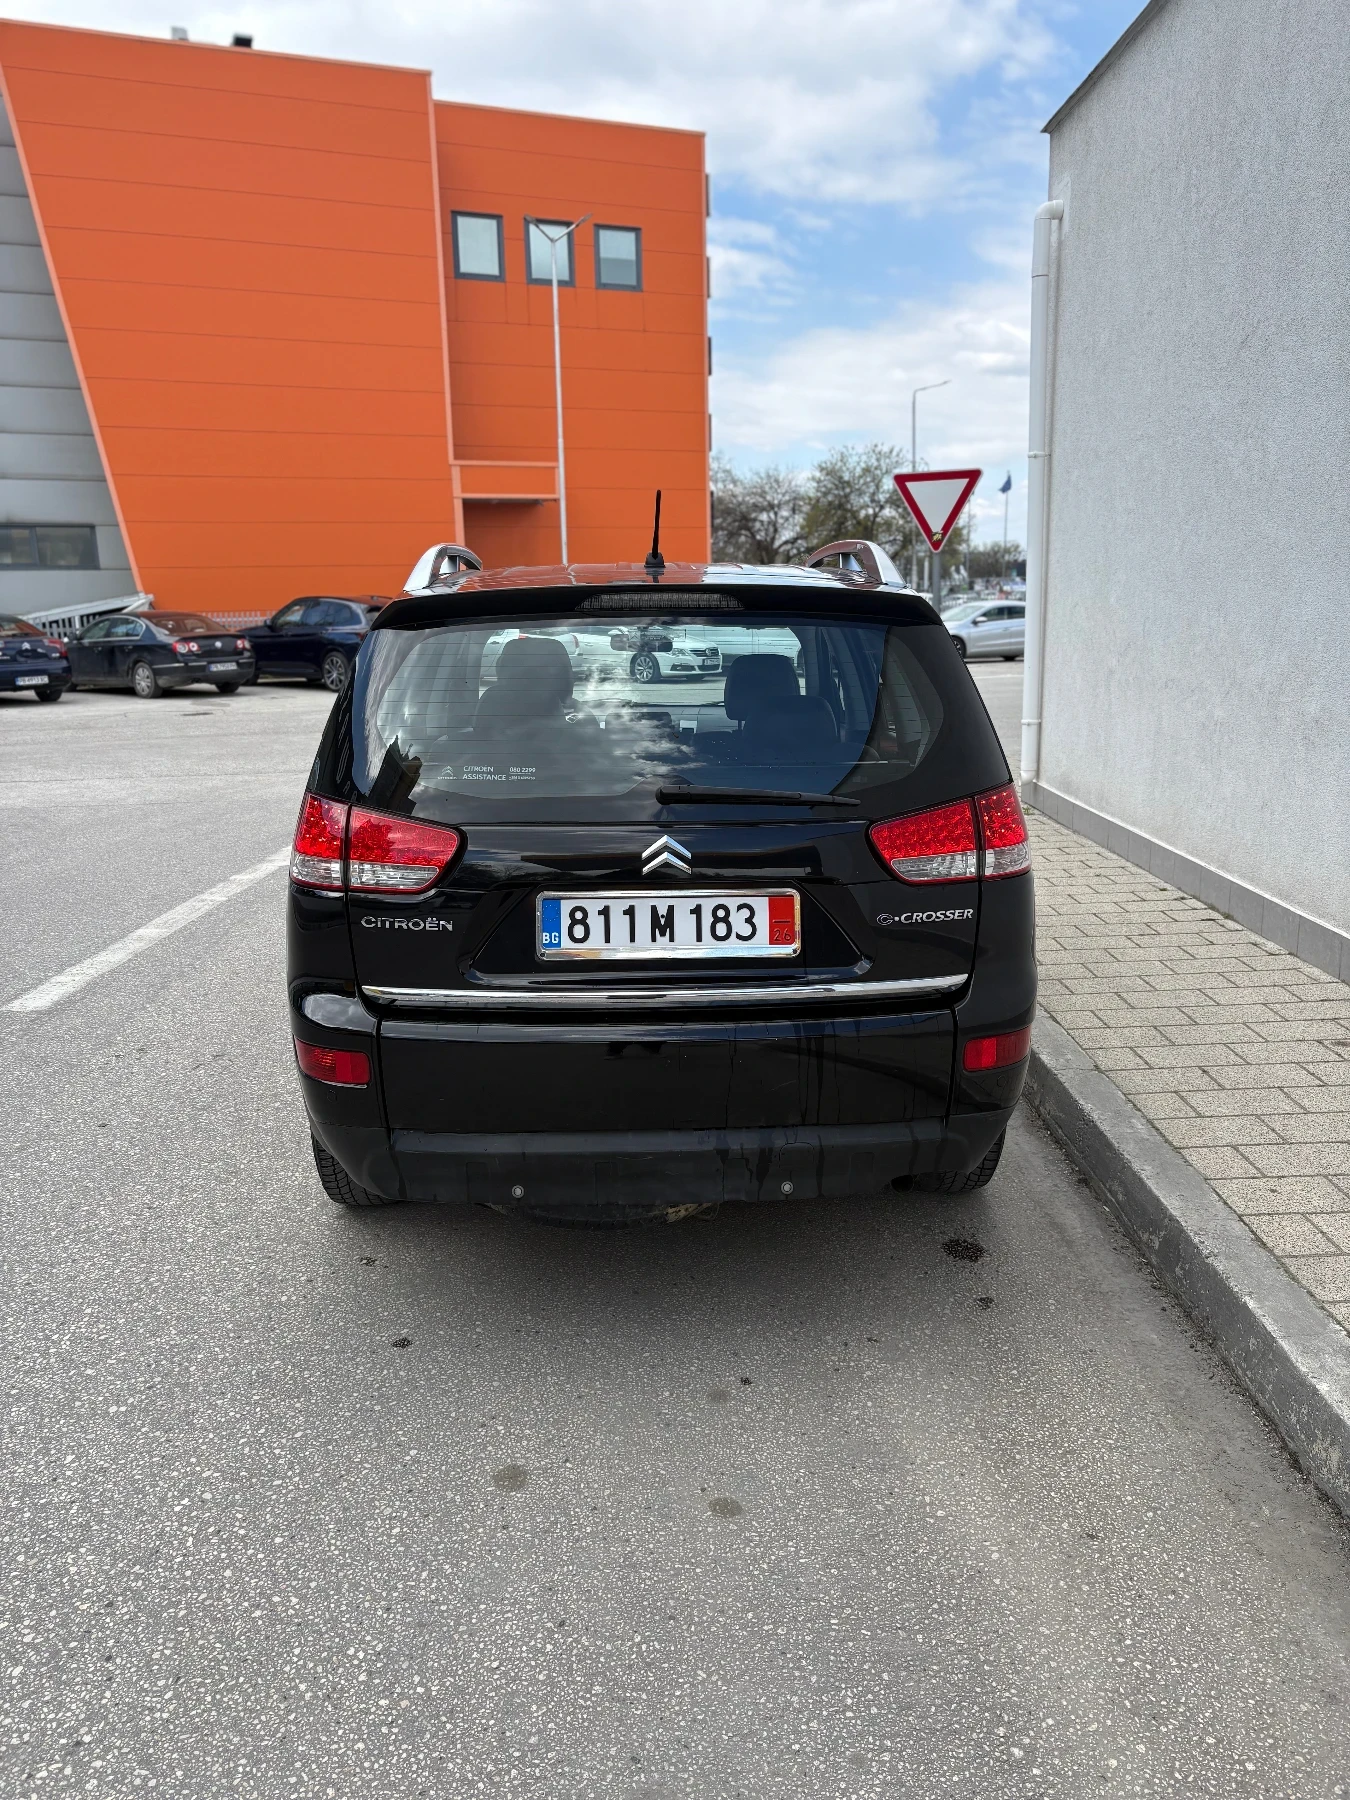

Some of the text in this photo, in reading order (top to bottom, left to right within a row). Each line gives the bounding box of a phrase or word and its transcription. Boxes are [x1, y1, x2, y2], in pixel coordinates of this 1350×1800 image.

[360, 916, 453, 931] CITROËN
[542, 932, 559, 944] BG
[773, 928, 792, 942] 26
